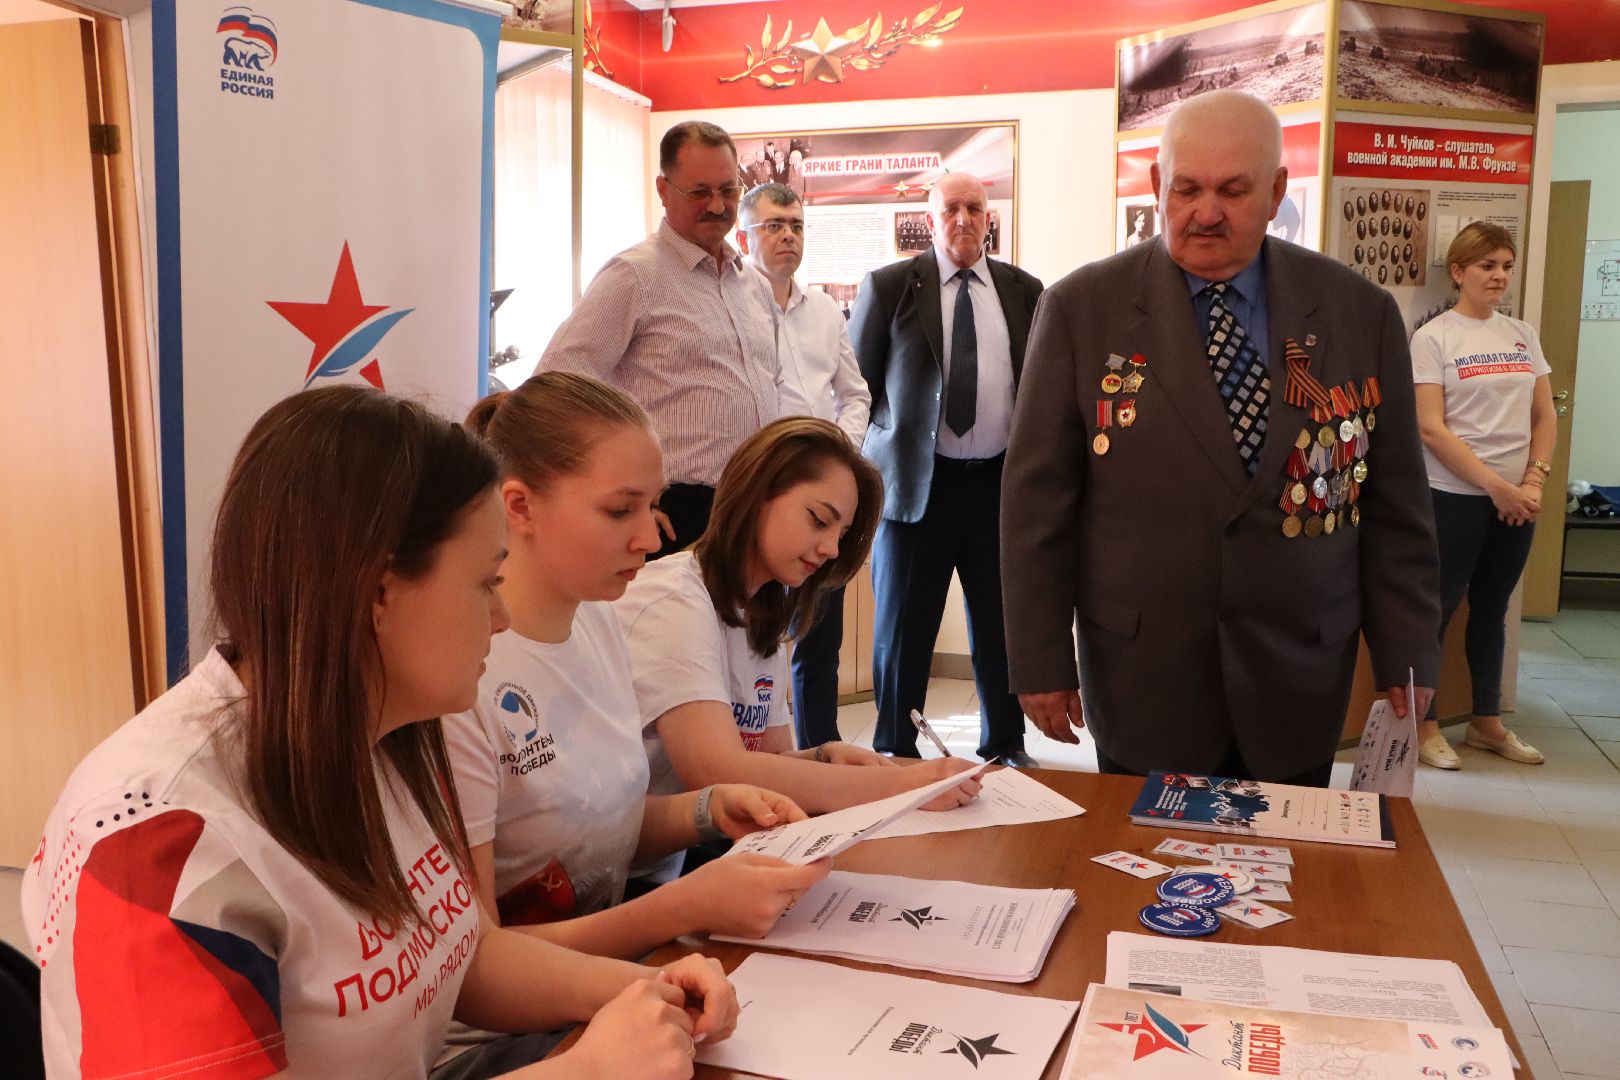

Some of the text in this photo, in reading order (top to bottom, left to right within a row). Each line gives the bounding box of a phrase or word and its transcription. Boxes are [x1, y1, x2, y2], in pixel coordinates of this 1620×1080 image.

[220, 68, 274, 87] ЕДИНАЯ
[221, 81, 274, 100] РОССИЯ
[1374, 132, 1384, 148] В.
[1387, 133, 1398, 149] И.
[1400, 134, 1435, 153] Чуйков
[1444, 140, 1495, 155] слушатель
[804, 156, 940, 173] ЯРКИЕ ГРАНИ ТАЛАНТА
[1347, 151, 1518, 174] военной академии им. М.В. Фрунзе
[1454, 352, 1531, 367] МОЛОДАЯ ГВАРДИ
[414, 978, 438, 1020] МЫ
[888, 1022, 929, 1053] ПОБЕДЫ
[1221, 1020, 1245, 1071] Диктант
[1247, 1022, 1287, 1076] ПОБЕДЫ
